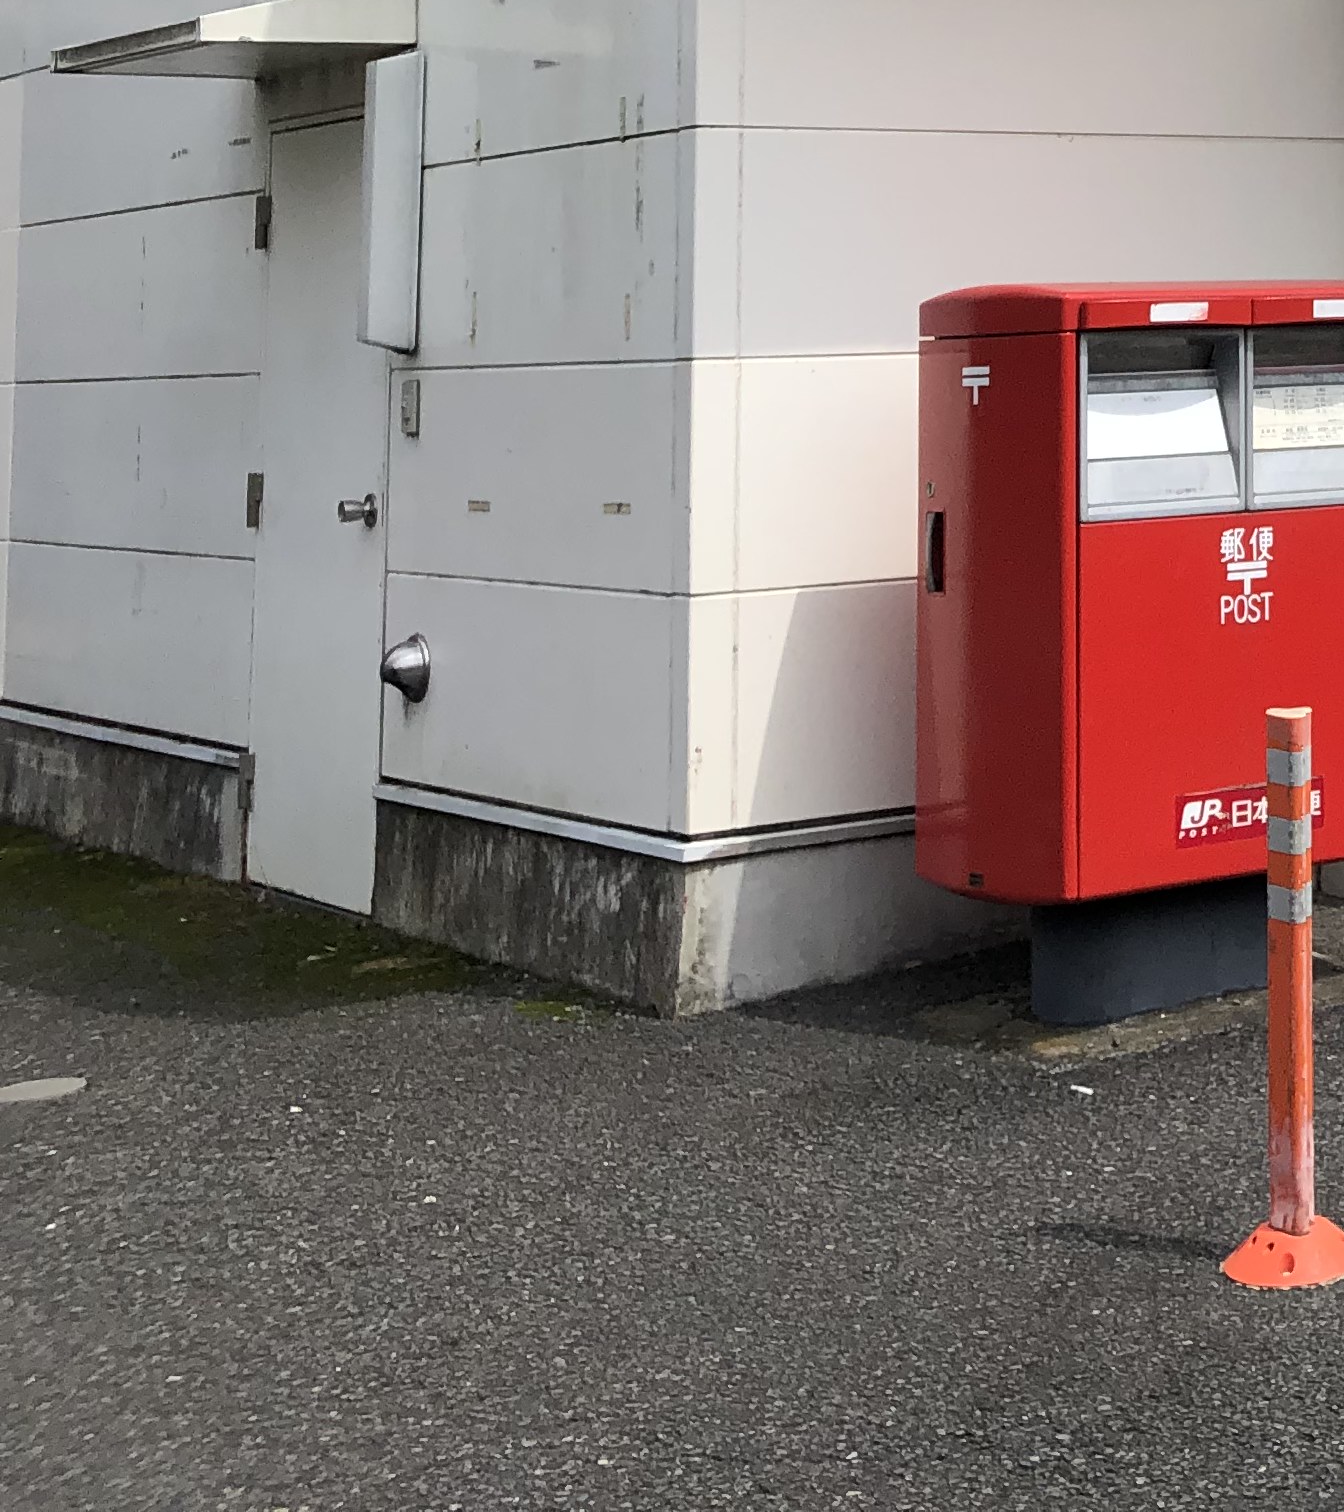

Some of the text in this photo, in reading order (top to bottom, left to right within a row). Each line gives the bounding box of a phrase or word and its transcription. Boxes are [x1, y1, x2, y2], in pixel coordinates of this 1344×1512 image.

[1219, 526, 1274, 563] 郵便
[1219, 590, 1274, 626] POST
[1178, 825, 1219, 840] POST
